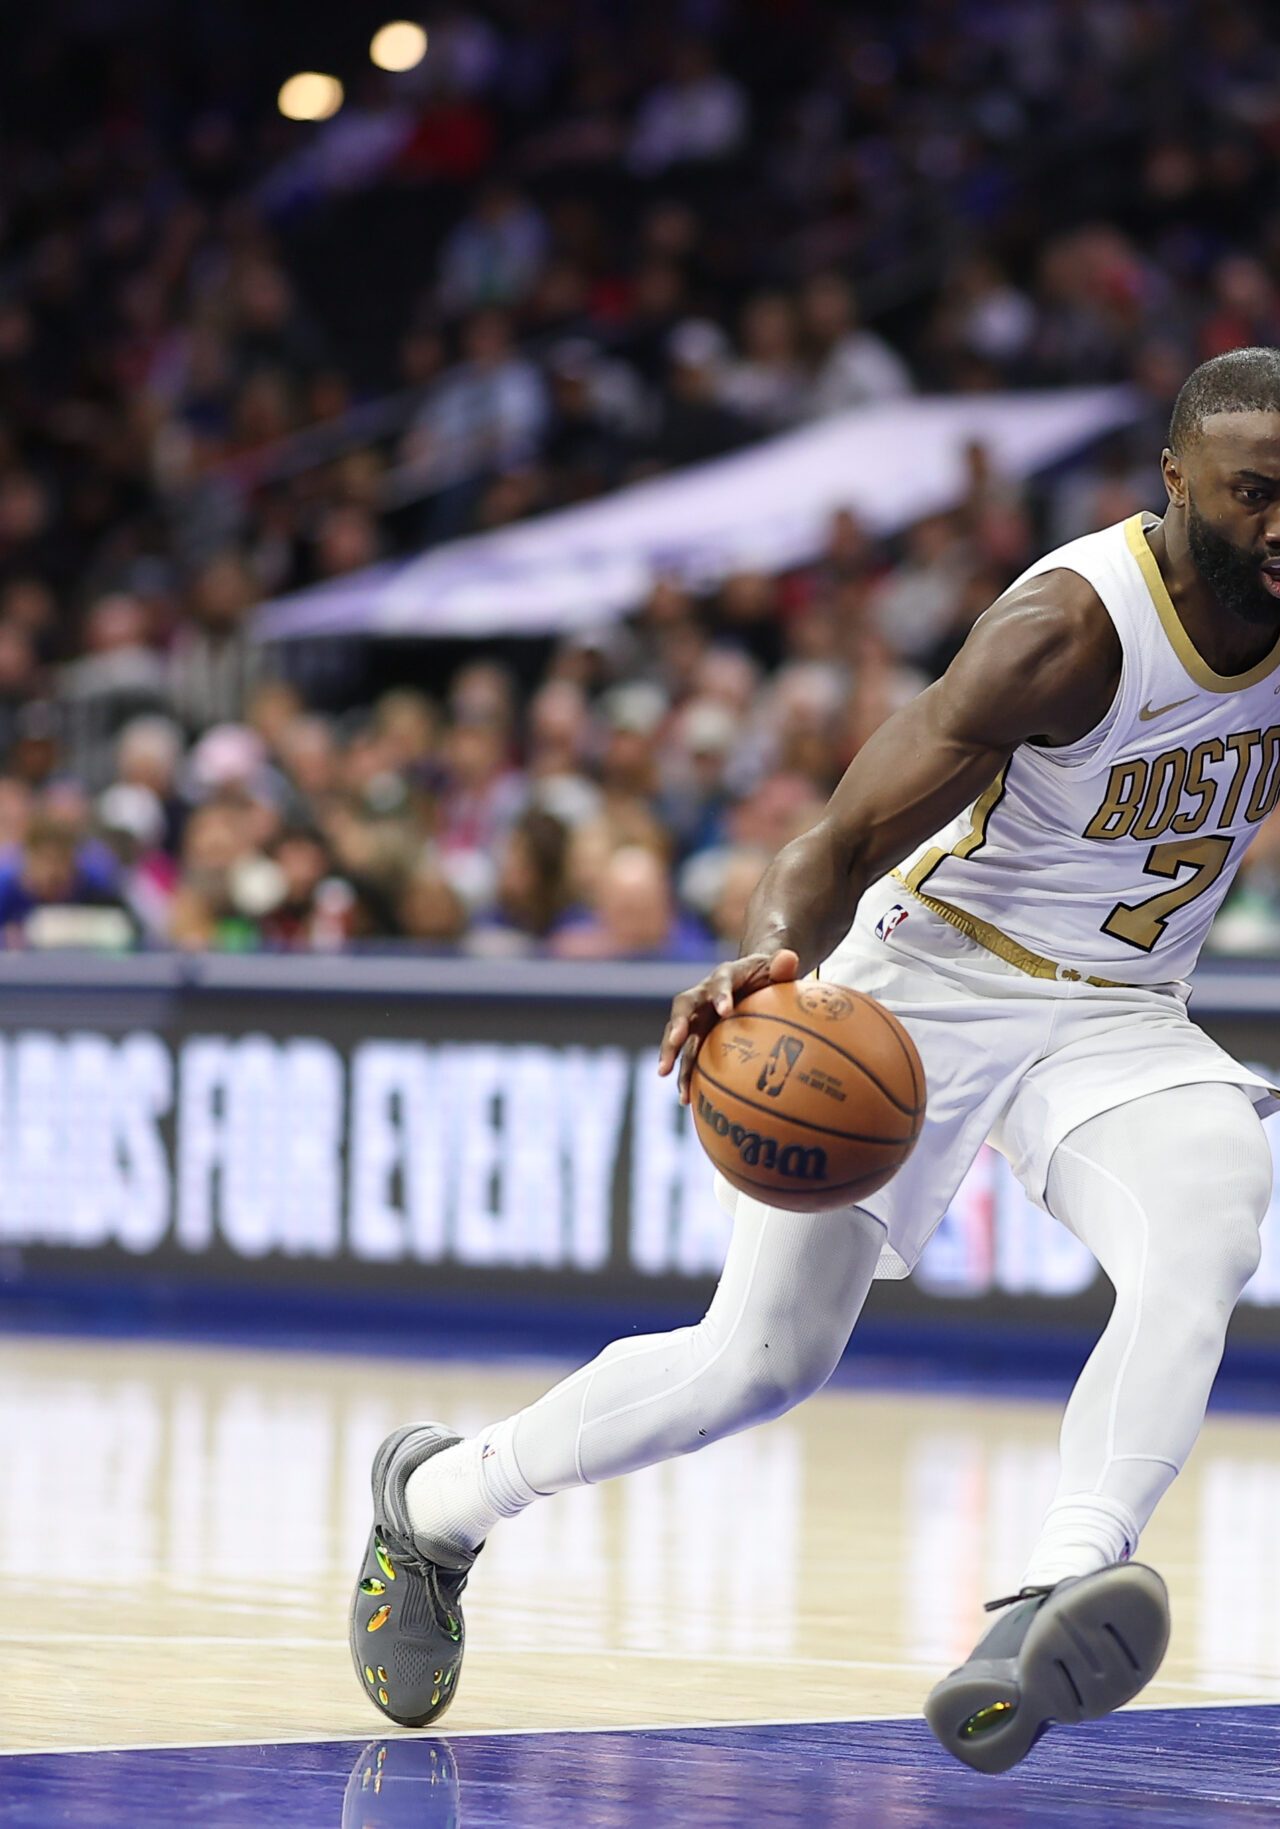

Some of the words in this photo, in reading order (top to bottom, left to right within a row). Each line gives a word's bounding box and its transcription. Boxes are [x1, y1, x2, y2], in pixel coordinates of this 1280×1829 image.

[1100, 835, 1236, 953] 7
[177, 1033, 342, 1258] FOR
[350, 1038, 629, 1273] EVERY
